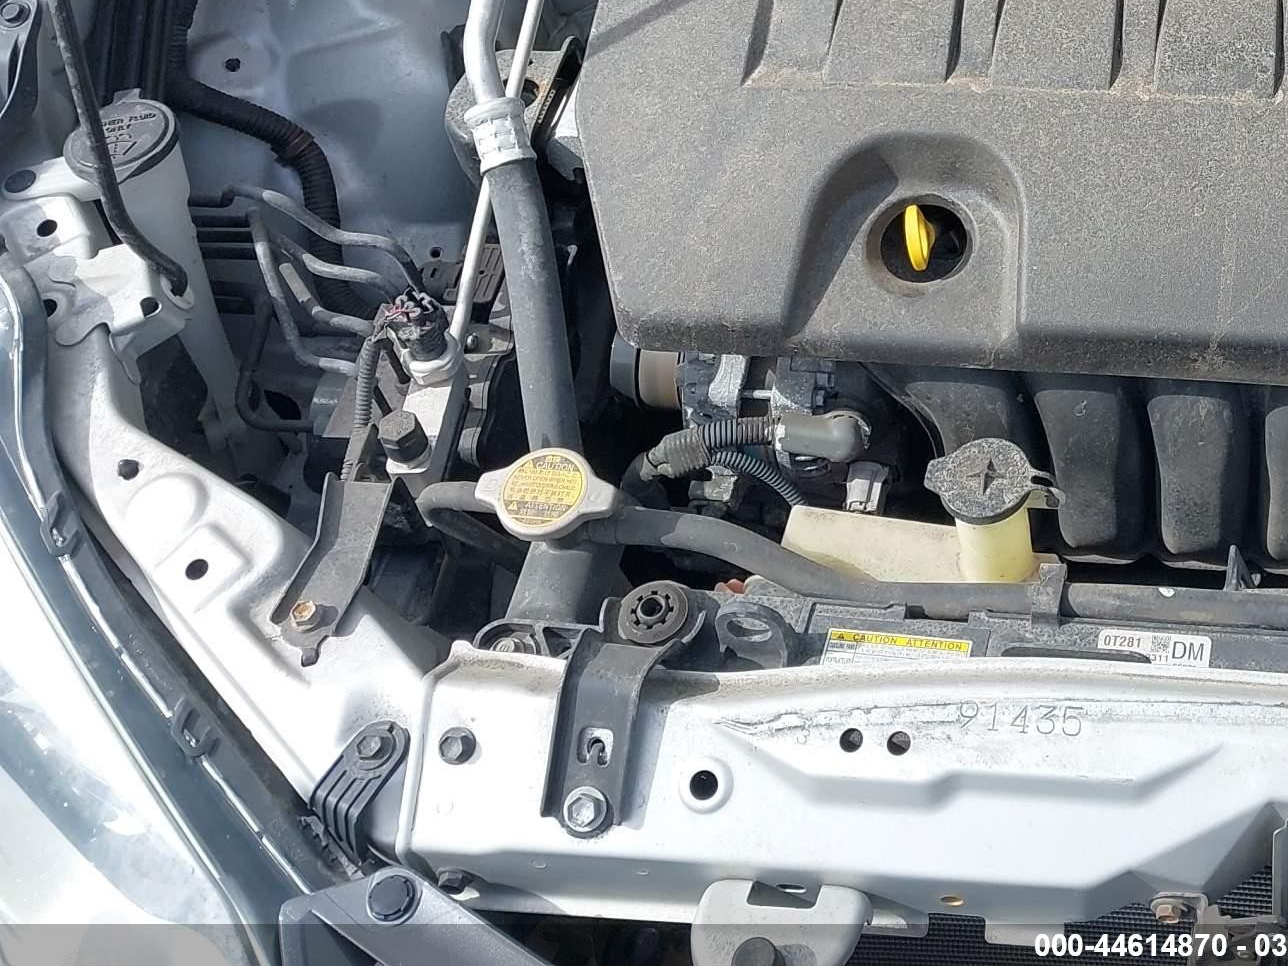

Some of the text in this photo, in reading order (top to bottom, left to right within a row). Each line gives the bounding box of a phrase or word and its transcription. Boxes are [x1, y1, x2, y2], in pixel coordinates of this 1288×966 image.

[104, 118, 124, 126] HER
[536, 462, 574, 471] CAUTION
[853, 634, 962, 650] CAUTION ATTENTION
[1172, 641, 1204, 661] DM
[959, 700, 1084, 736] 91435
